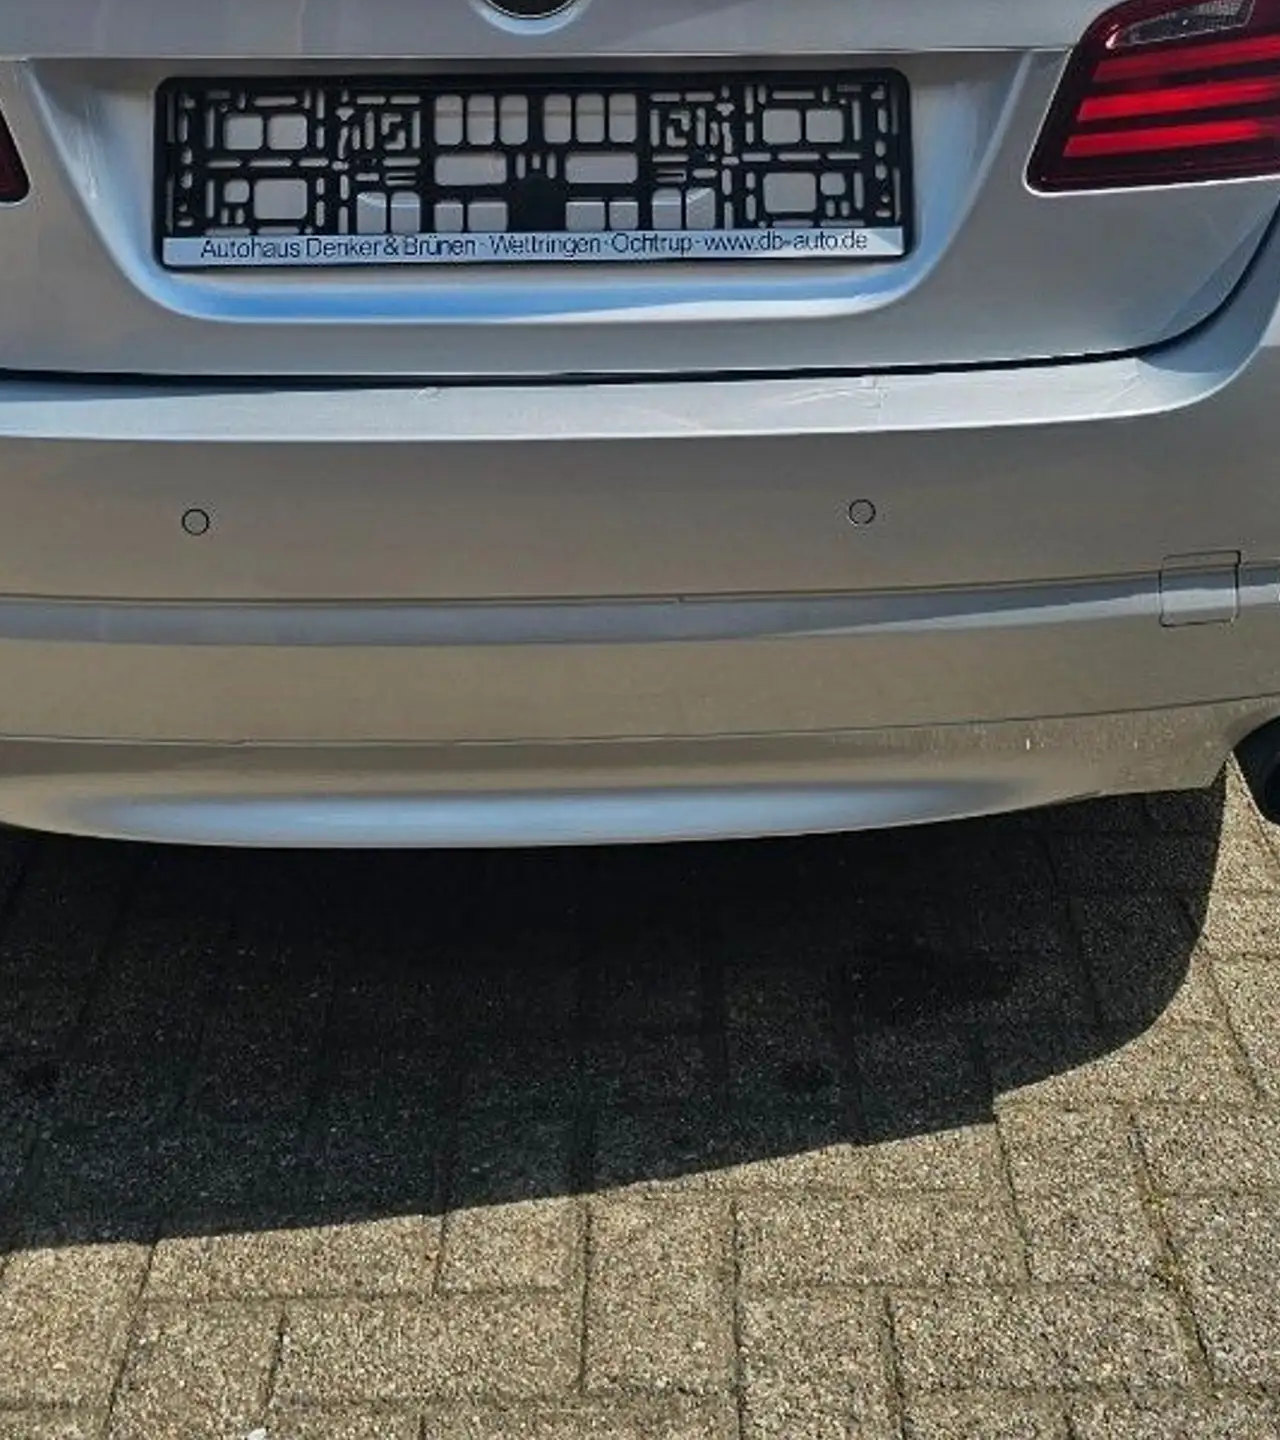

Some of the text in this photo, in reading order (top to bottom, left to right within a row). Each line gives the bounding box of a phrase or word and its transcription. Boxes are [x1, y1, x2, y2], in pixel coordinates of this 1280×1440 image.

[200, 230, 868, 258] Autohaus Denker & Brünen Wettringen Ochtrup www.db-auto.de
